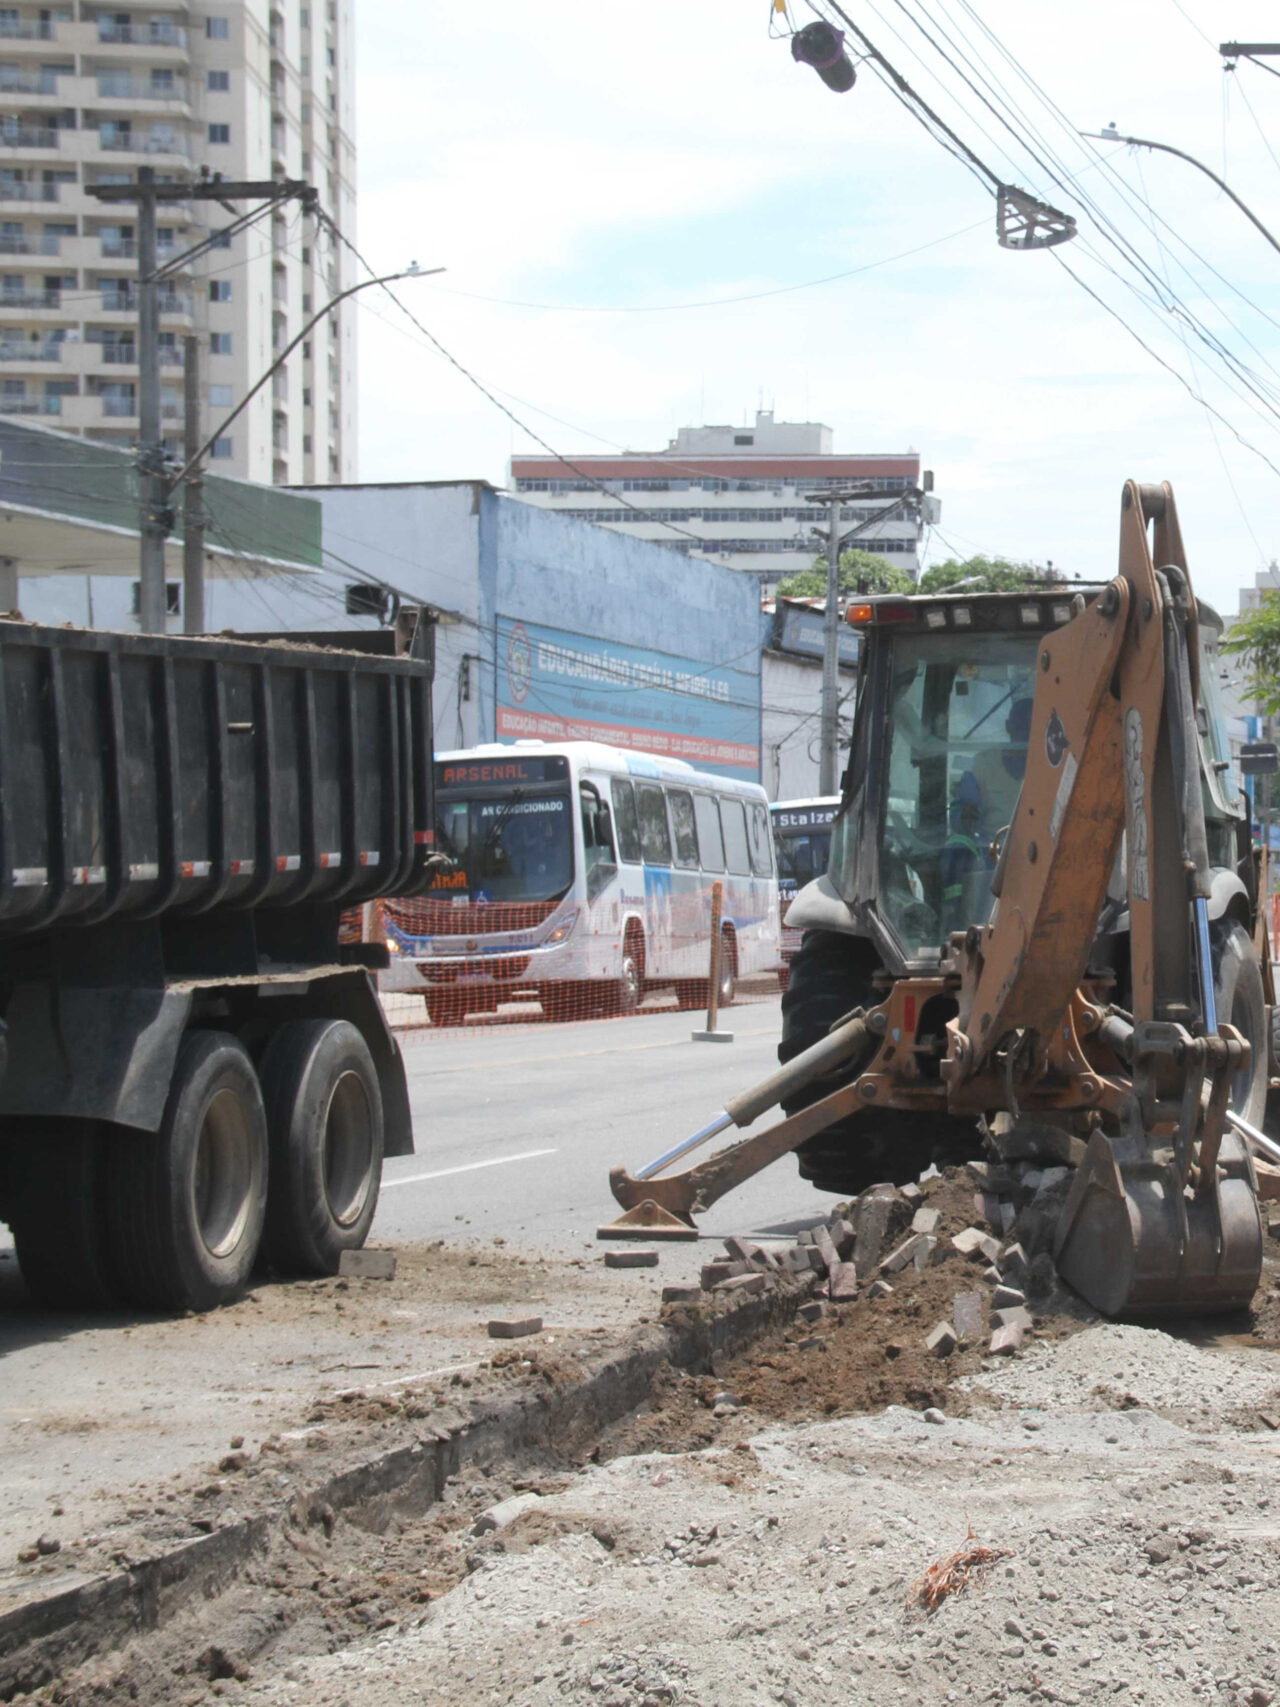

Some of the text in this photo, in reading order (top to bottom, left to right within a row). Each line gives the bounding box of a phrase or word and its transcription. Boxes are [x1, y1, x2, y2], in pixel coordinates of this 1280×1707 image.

[444, 764, 529, 783] ARSENAL
[481, 805, 495, 817] AR
[780, 813, 808, 827] Sta
